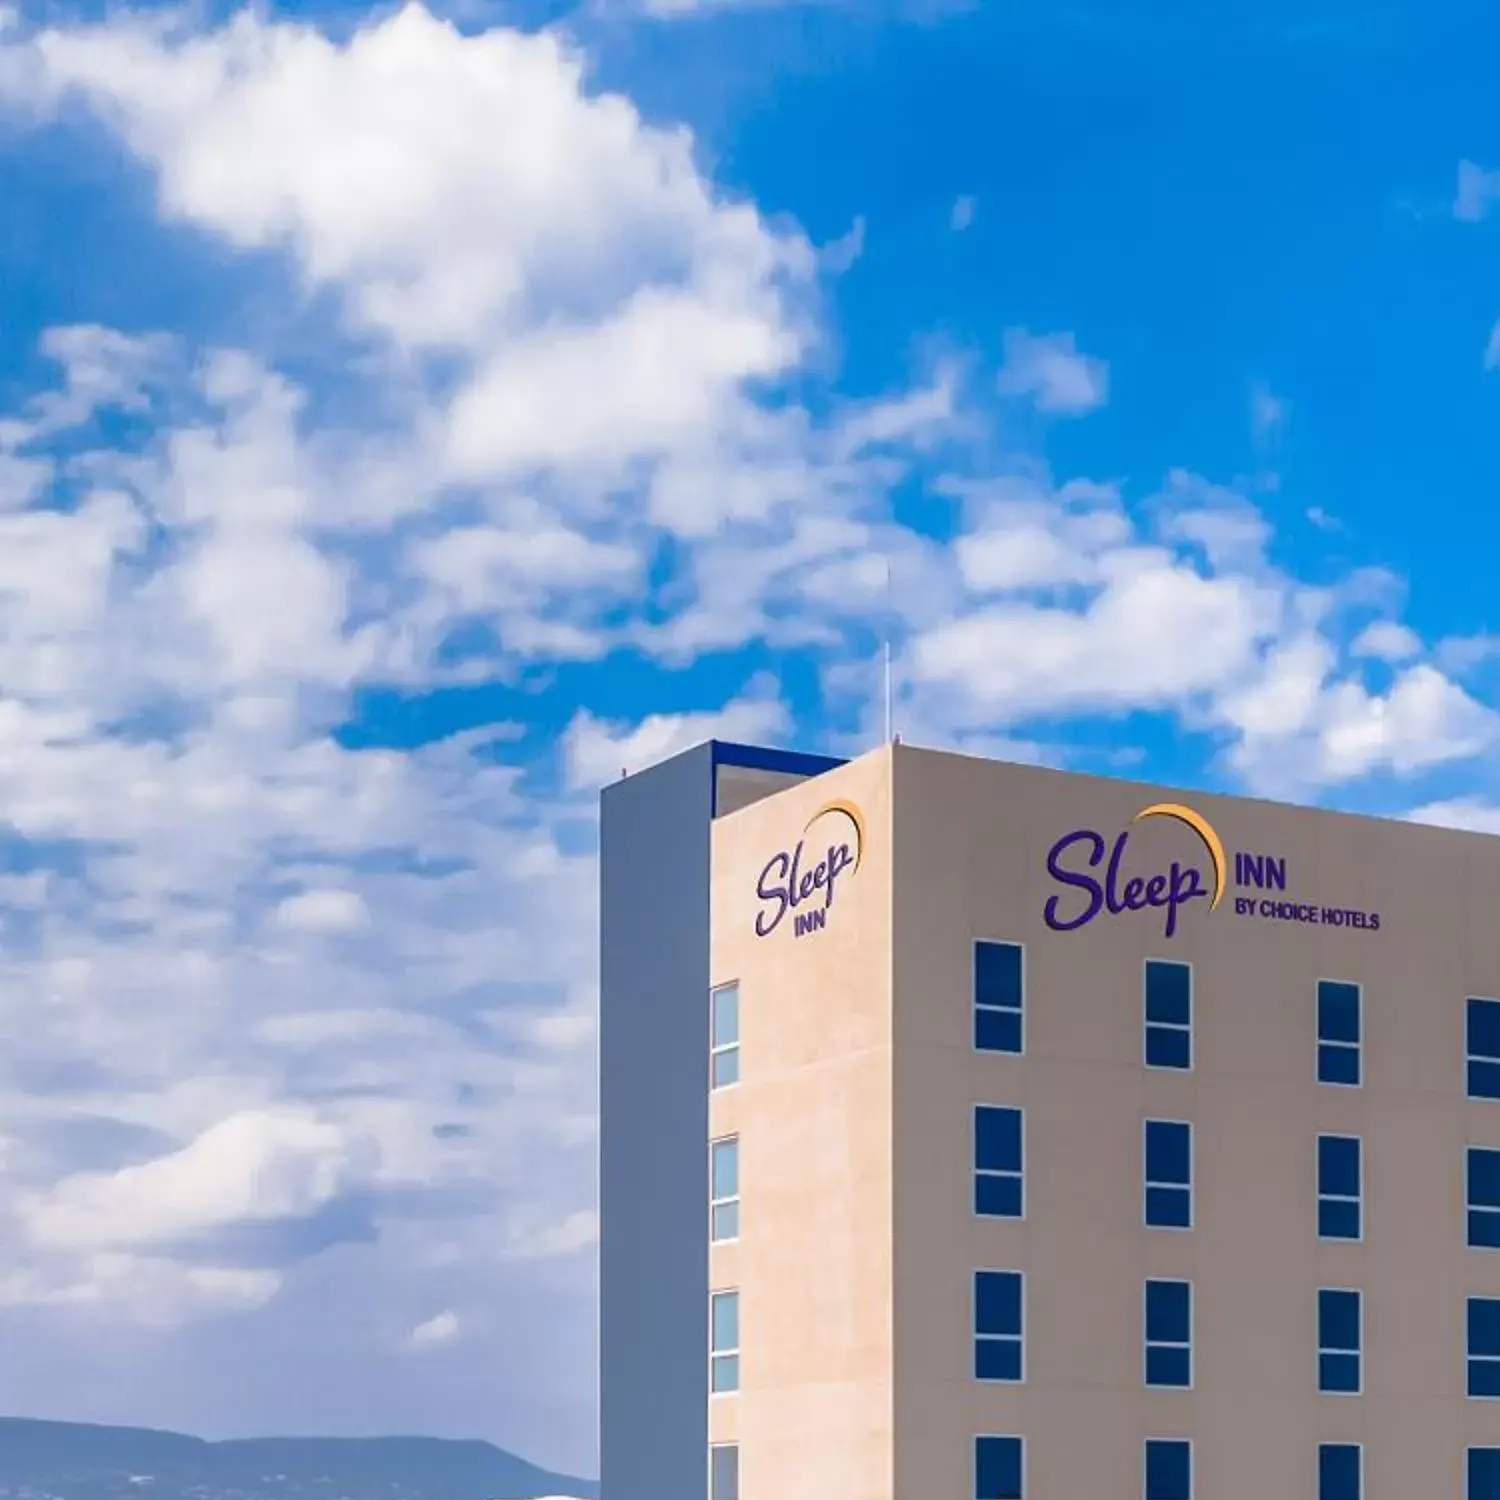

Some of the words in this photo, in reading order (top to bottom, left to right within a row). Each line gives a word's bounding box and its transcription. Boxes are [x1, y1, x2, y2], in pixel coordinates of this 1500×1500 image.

[756, 839, 854, 937] Sleep
[1044, 830, 1208, 938] Sleep
[1235, 852, 1286, 890] INN
[1234, 897, 1257, 916] BY
[1260, 900, 1319, 923] CHOICE
[1321, 908, 1380, 931] HOTELS
[794, 907, 826, 938] INN
